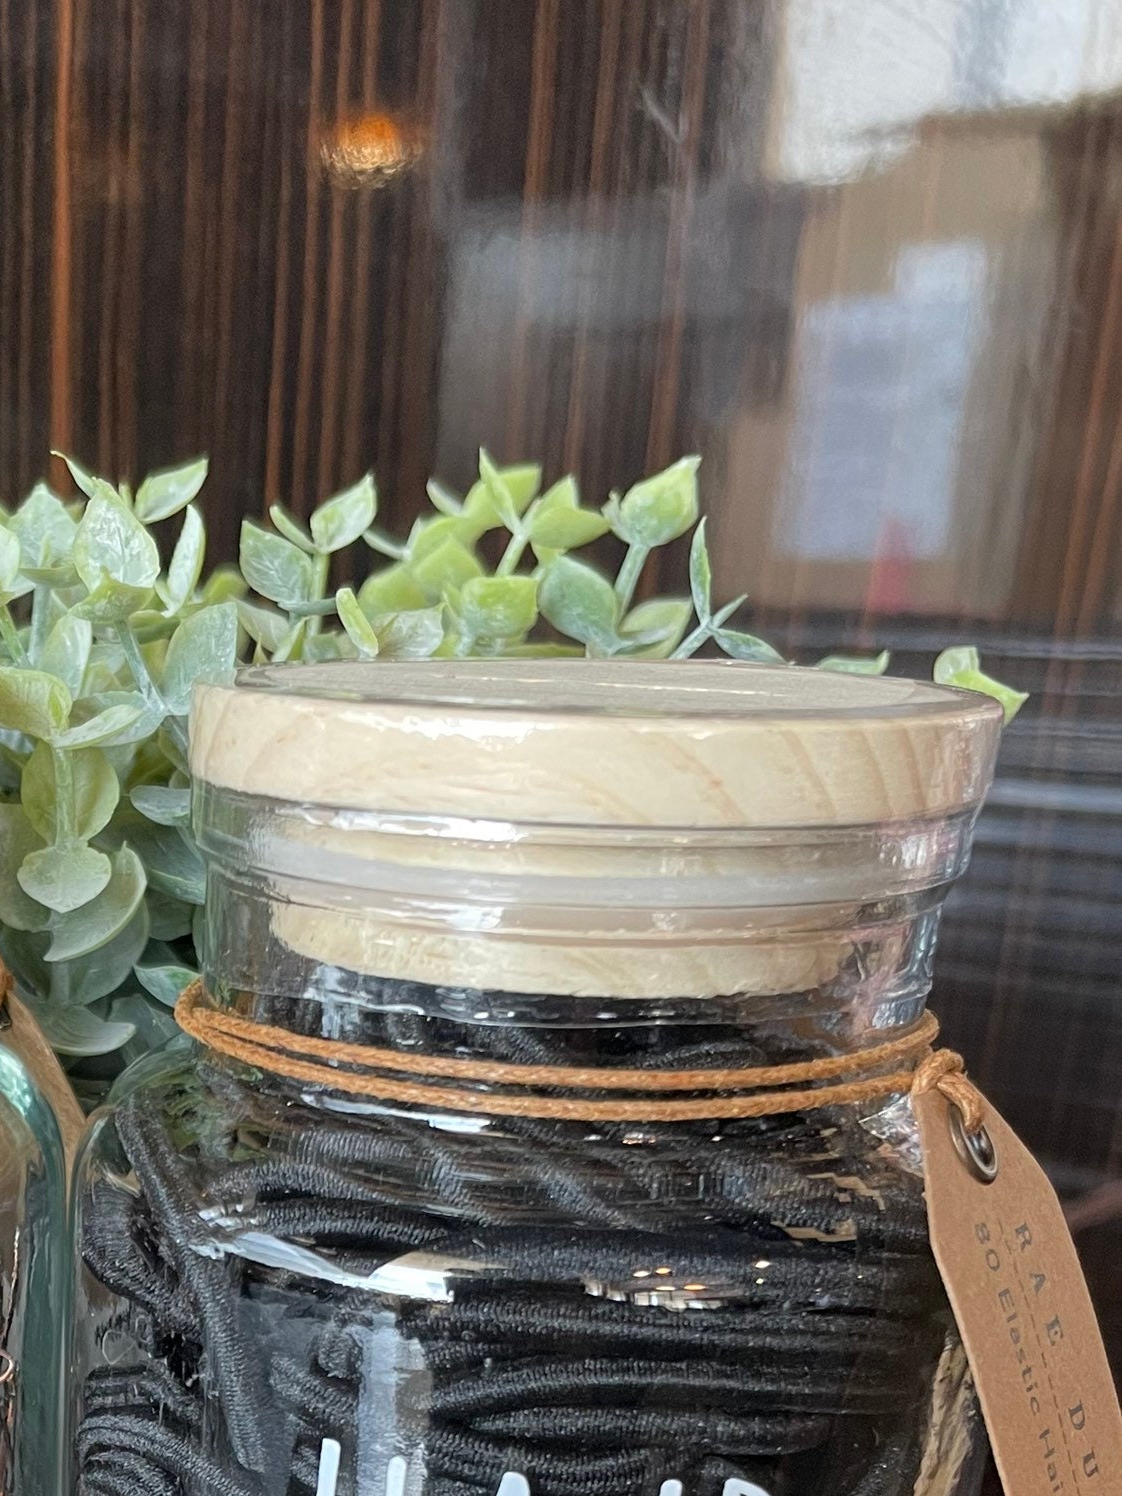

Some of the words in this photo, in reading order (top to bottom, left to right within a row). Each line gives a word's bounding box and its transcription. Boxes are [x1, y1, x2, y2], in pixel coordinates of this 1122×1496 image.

[974, 1222, 1001, 1272] 80
[998, 1288, 1040, 1416] Elastic
[1014, 1221, 1064, 1347] RAE
